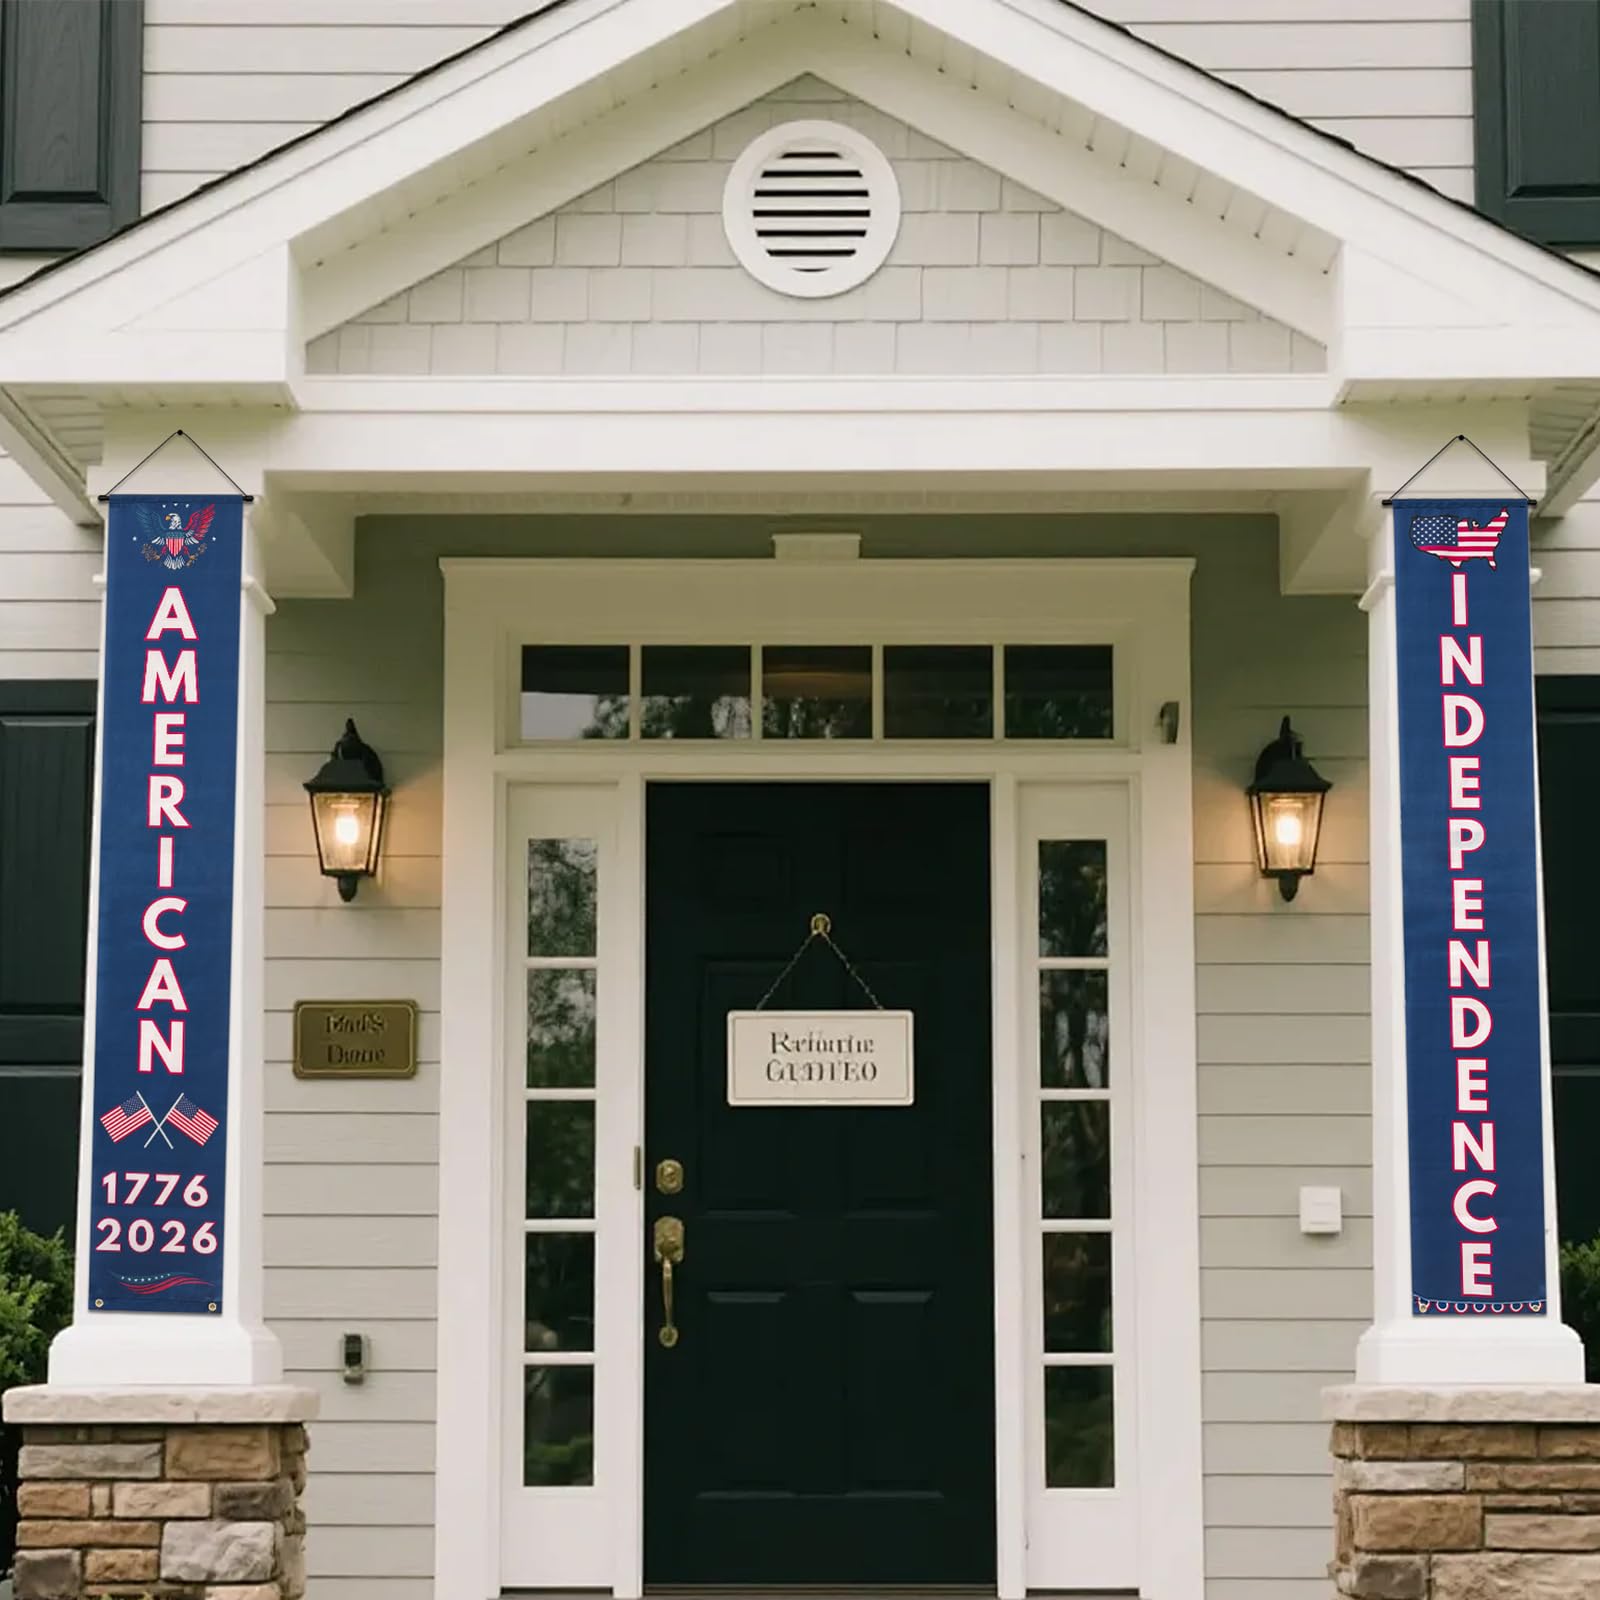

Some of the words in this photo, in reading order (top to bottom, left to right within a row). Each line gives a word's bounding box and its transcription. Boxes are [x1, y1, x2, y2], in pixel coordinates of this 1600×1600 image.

[136, 585, 201, 1075] AMERICAN
[1439, 572, 1498, 1297] INDEPENDENCE
[95, 1217, 218, 1255] 2026
[101, 1171, 209, 1208] 1776
